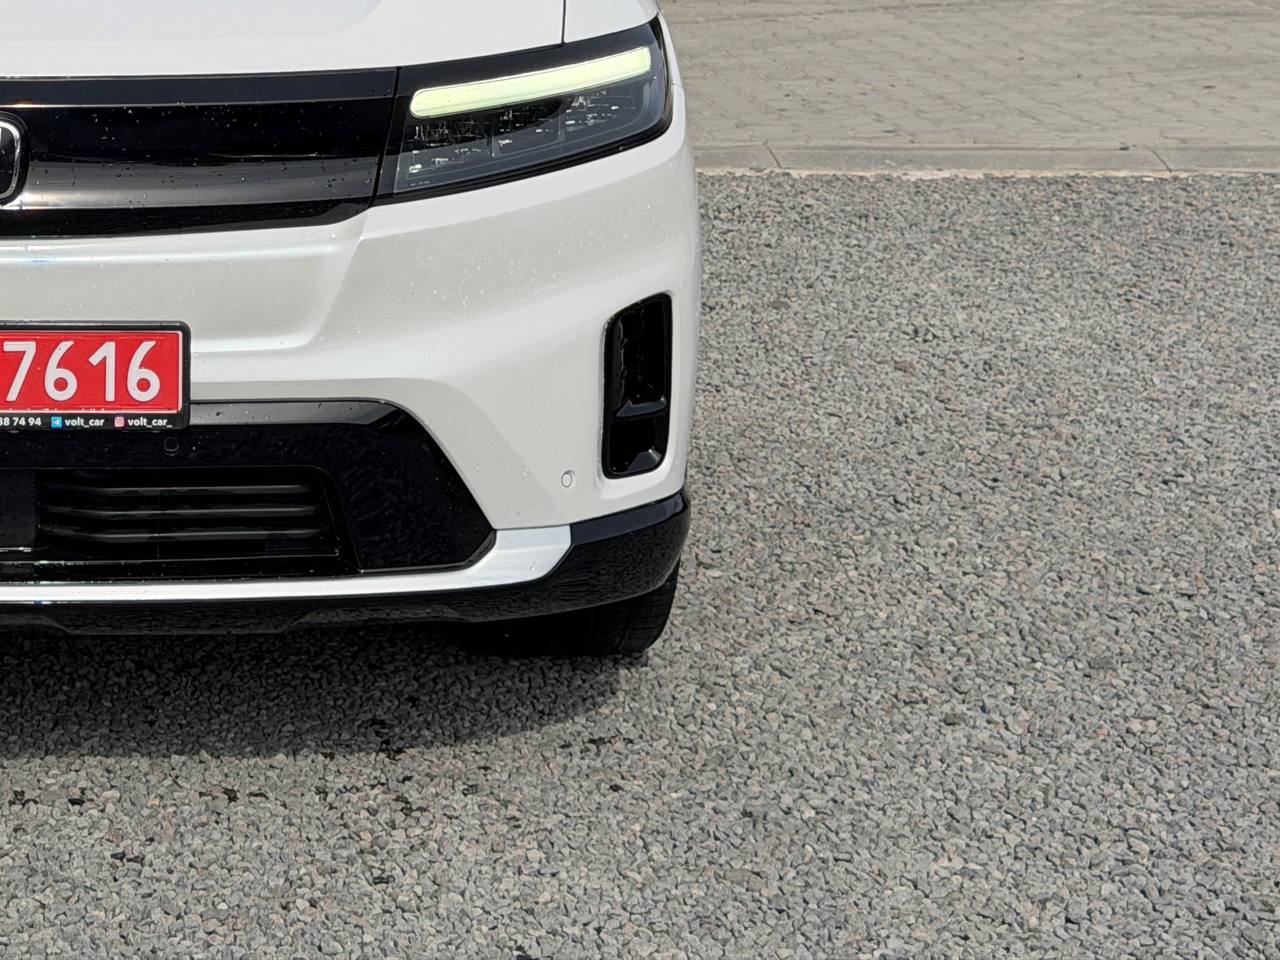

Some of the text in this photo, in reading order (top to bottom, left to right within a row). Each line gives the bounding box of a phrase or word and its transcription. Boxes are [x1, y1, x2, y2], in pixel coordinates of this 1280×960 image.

[2, 340, 161, 402] 7616
[13, 416, 26, 426] 74
[28, 416, 42, 426] 94
[64, 416, 105, 428] volt_car
